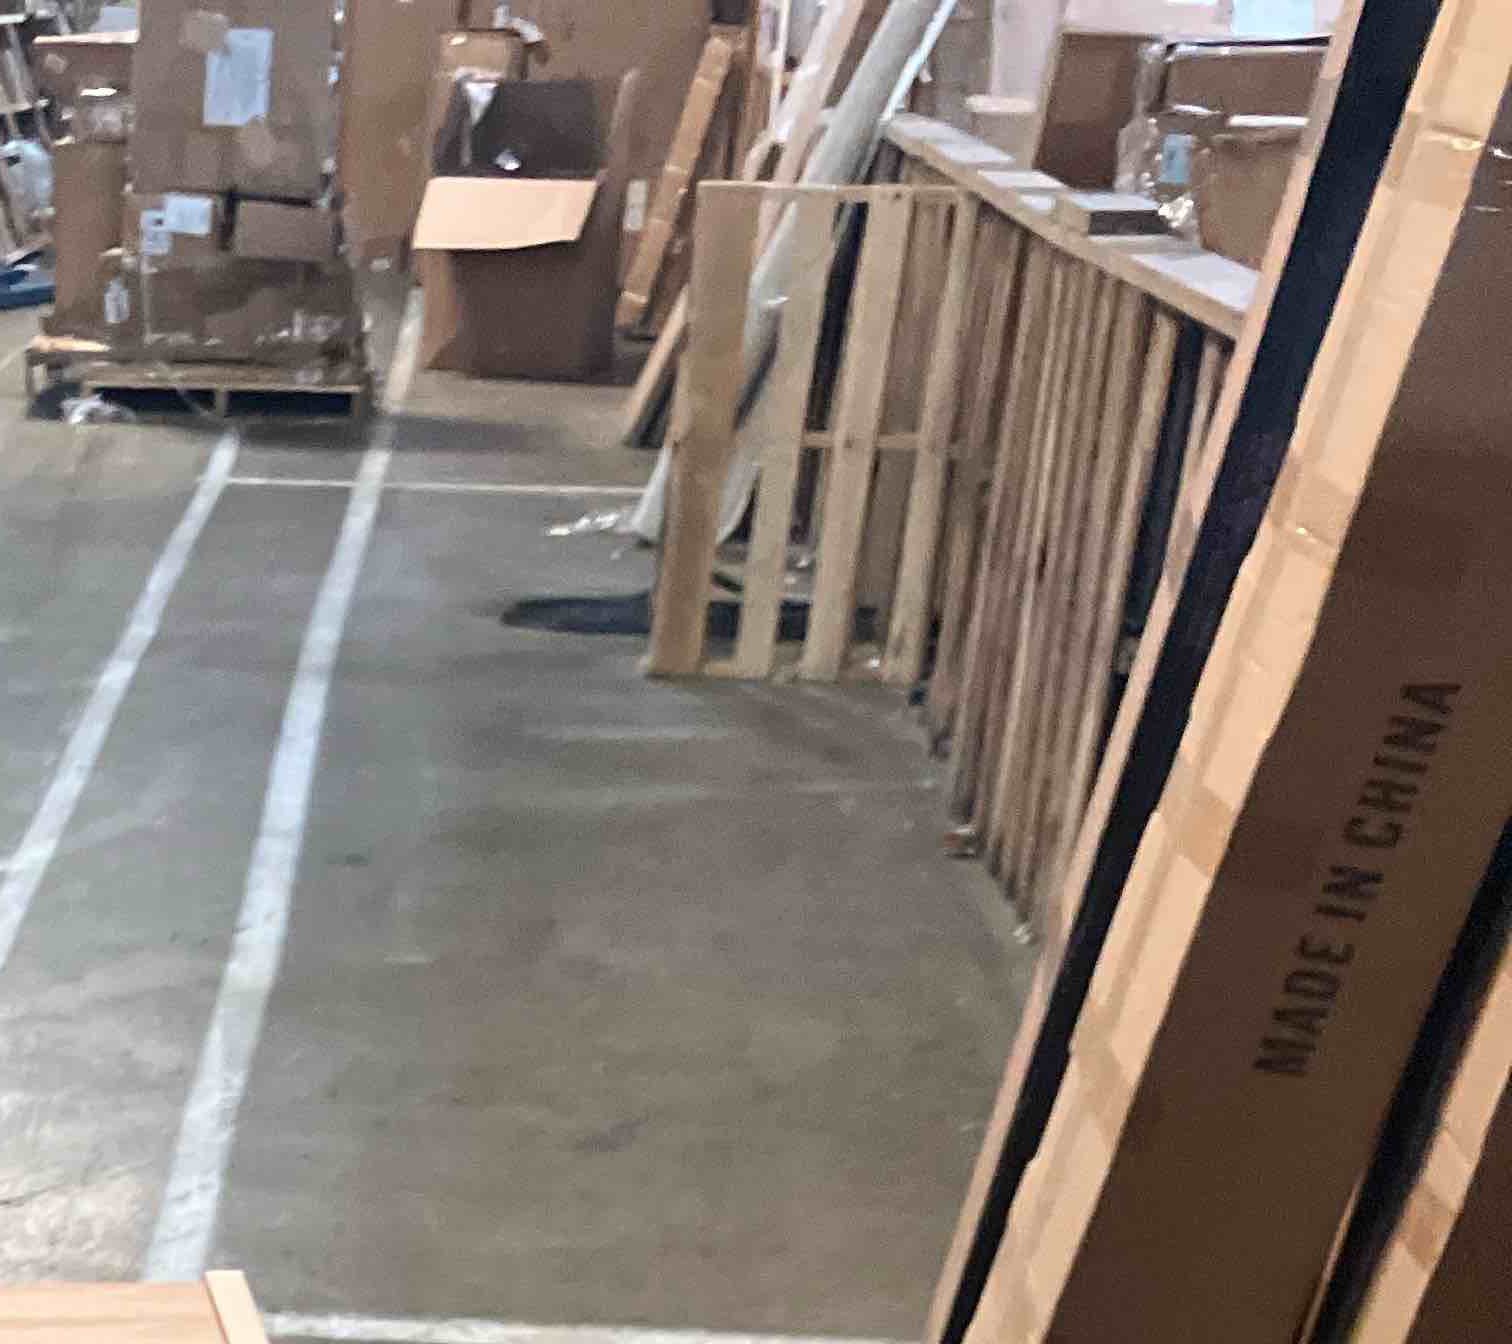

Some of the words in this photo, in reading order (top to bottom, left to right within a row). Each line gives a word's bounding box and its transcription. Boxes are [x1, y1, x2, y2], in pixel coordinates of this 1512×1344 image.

[1344, 681, 1463, 849] CHINA
[1315, 864, 1384, 923] IN
[1253, 938, 1355, 1077] MADE
